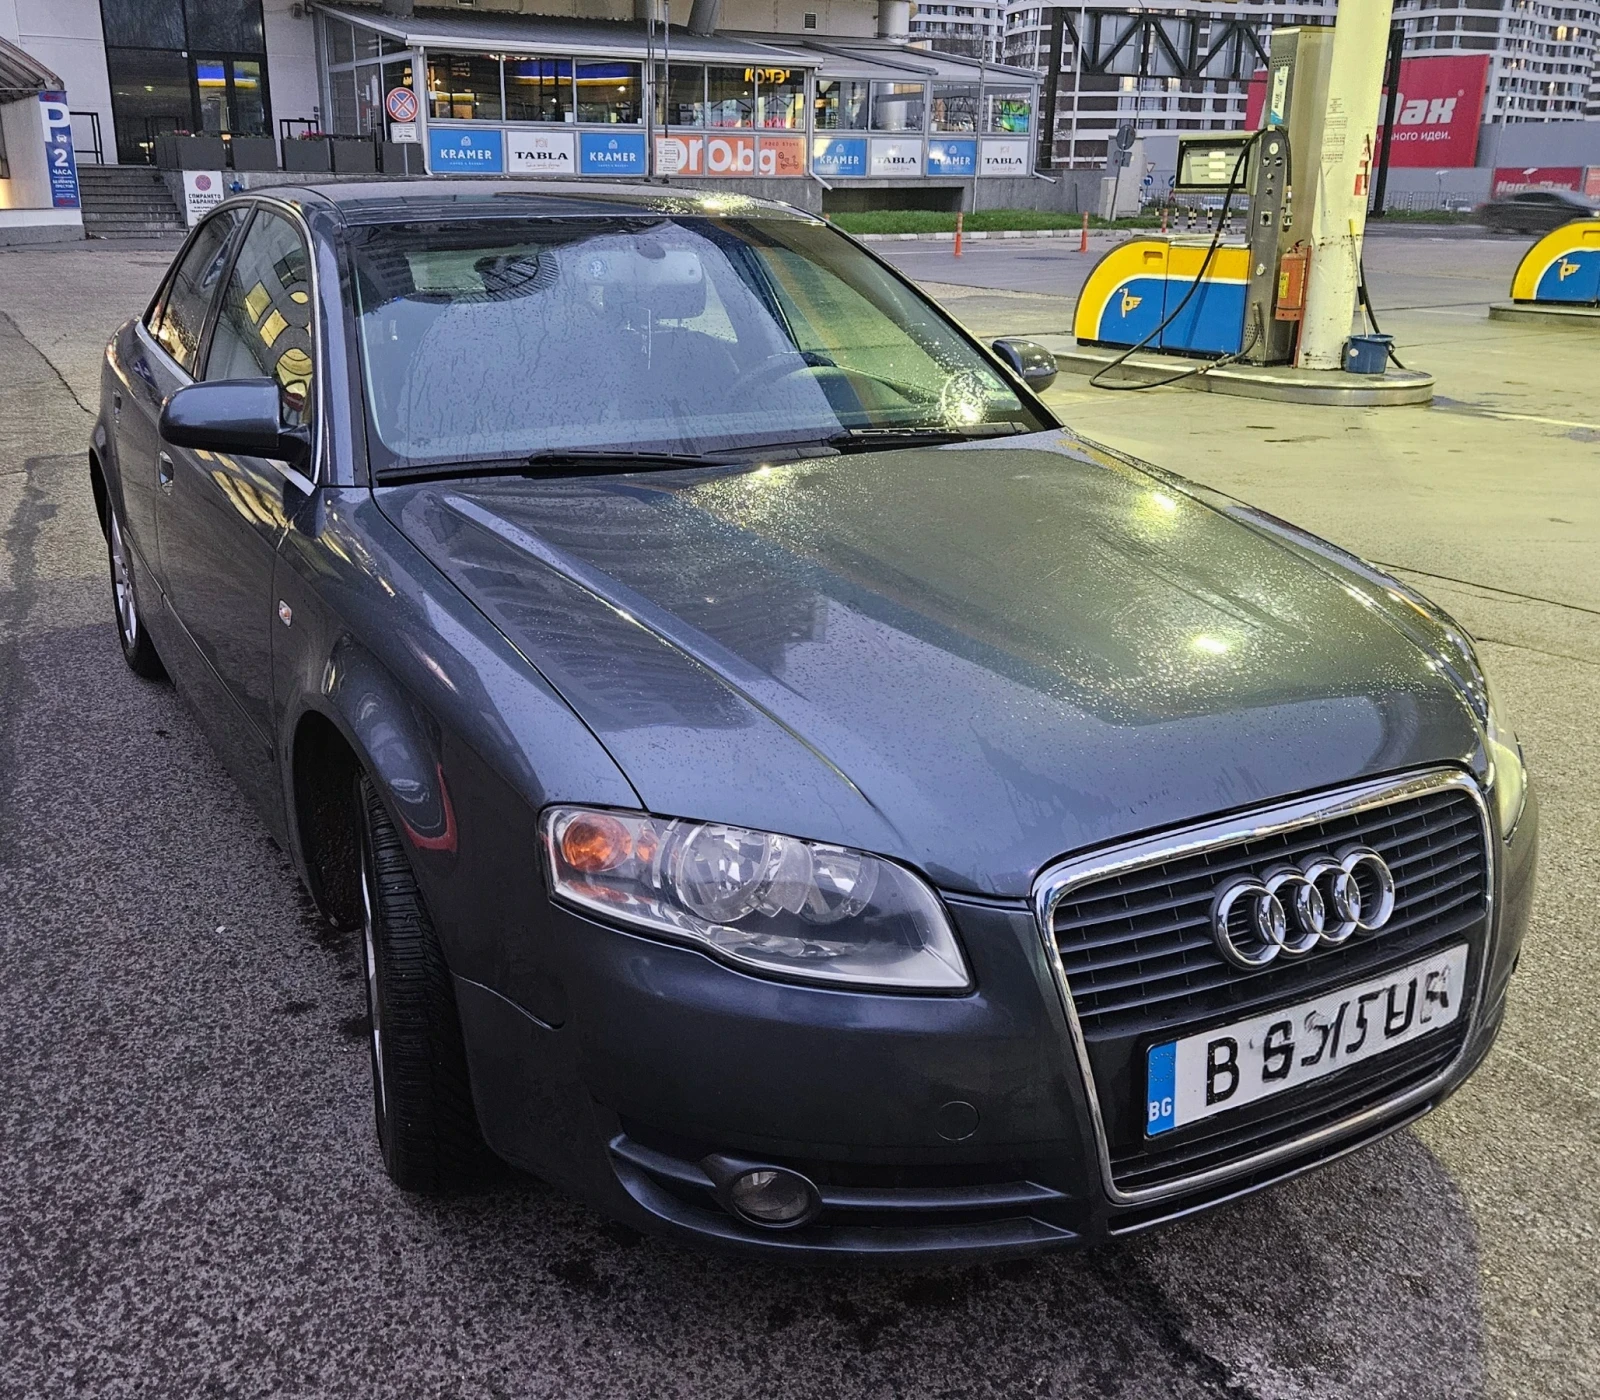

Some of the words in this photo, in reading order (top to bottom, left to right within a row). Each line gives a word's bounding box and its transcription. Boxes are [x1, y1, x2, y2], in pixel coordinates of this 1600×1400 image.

[1391, 131, 1418, 141] ного
[1420, 131, 1451, 142] идеи.
[53, 148, 69, 167] 2
[440, 149, 492, 160] KRAMER
[514, 151, 569, 160] TABLA
[589, 152, 636, 162] KRAMER
[819, 155, 859, 164] KRAMER
[934, 156, 971, 165] KRAMER
[1148, 1097, 1172, 1122] BG
